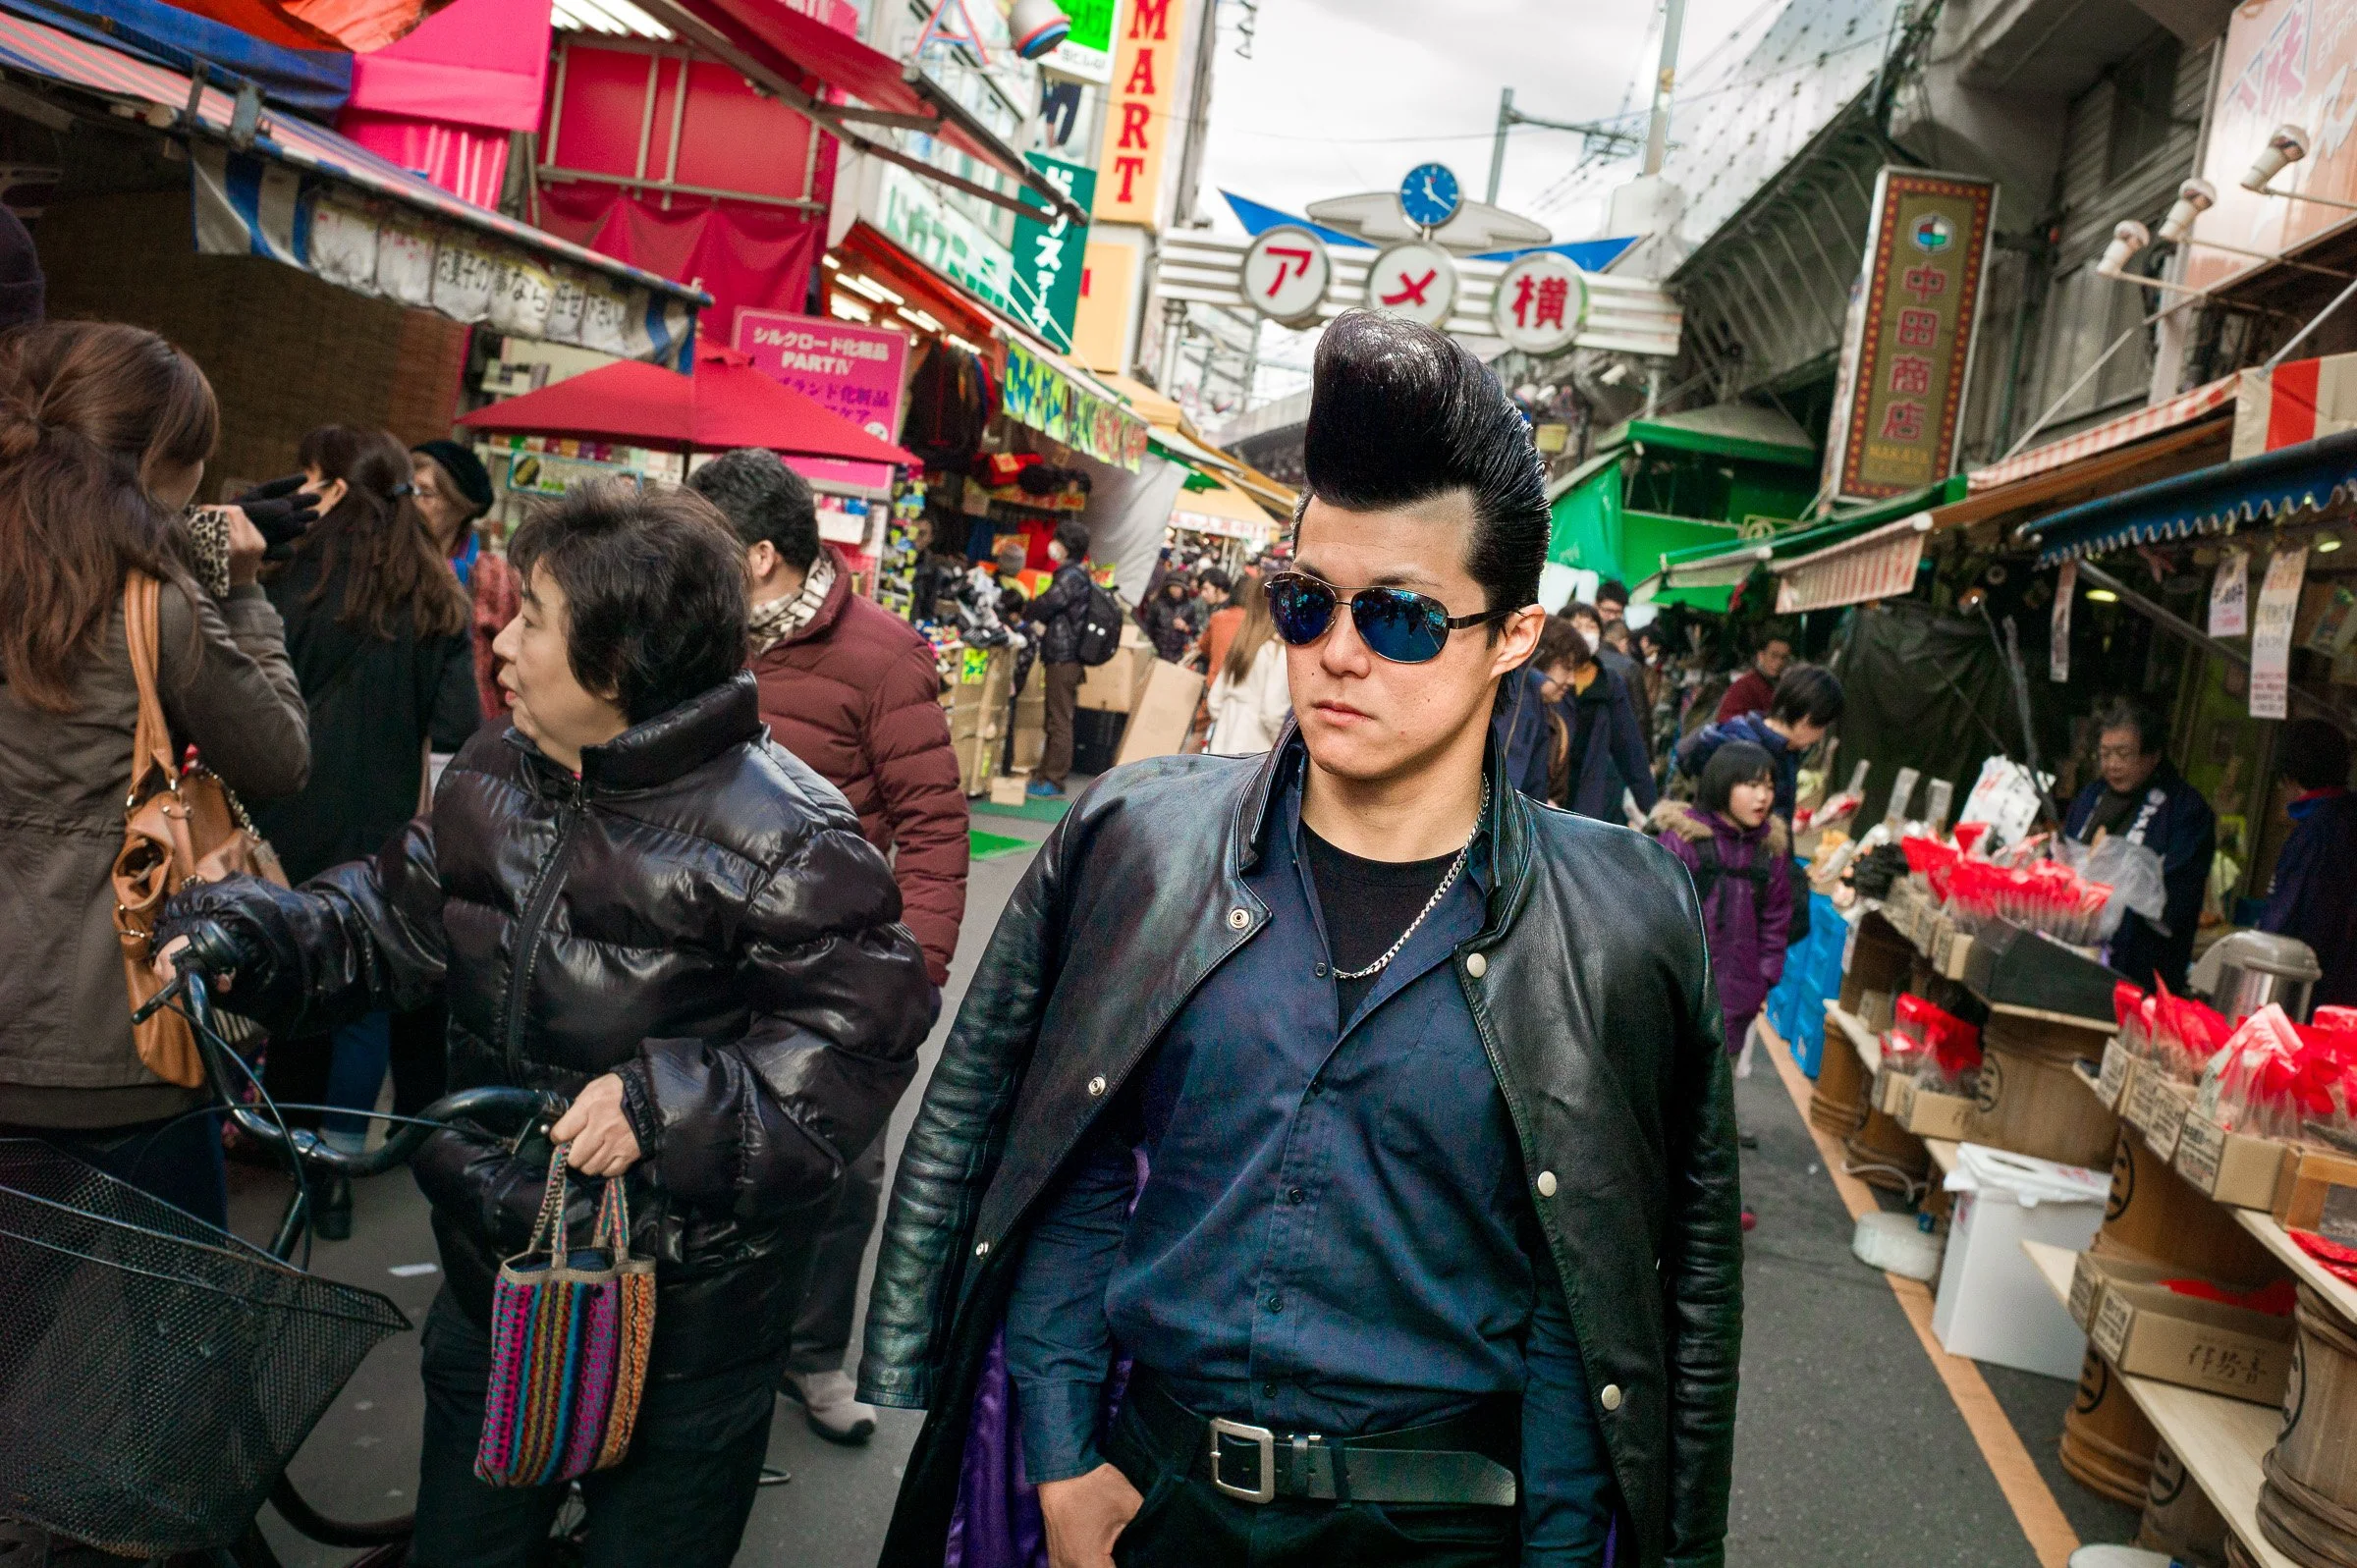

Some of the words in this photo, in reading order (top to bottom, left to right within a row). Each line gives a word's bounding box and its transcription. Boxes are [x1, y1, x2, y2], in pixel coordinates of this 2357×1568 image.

[1114, 0, 1170, 203] MART
[1265, 245, 1569, 331] アメ横
[1880, 262, 1947, 442] 中田商店
